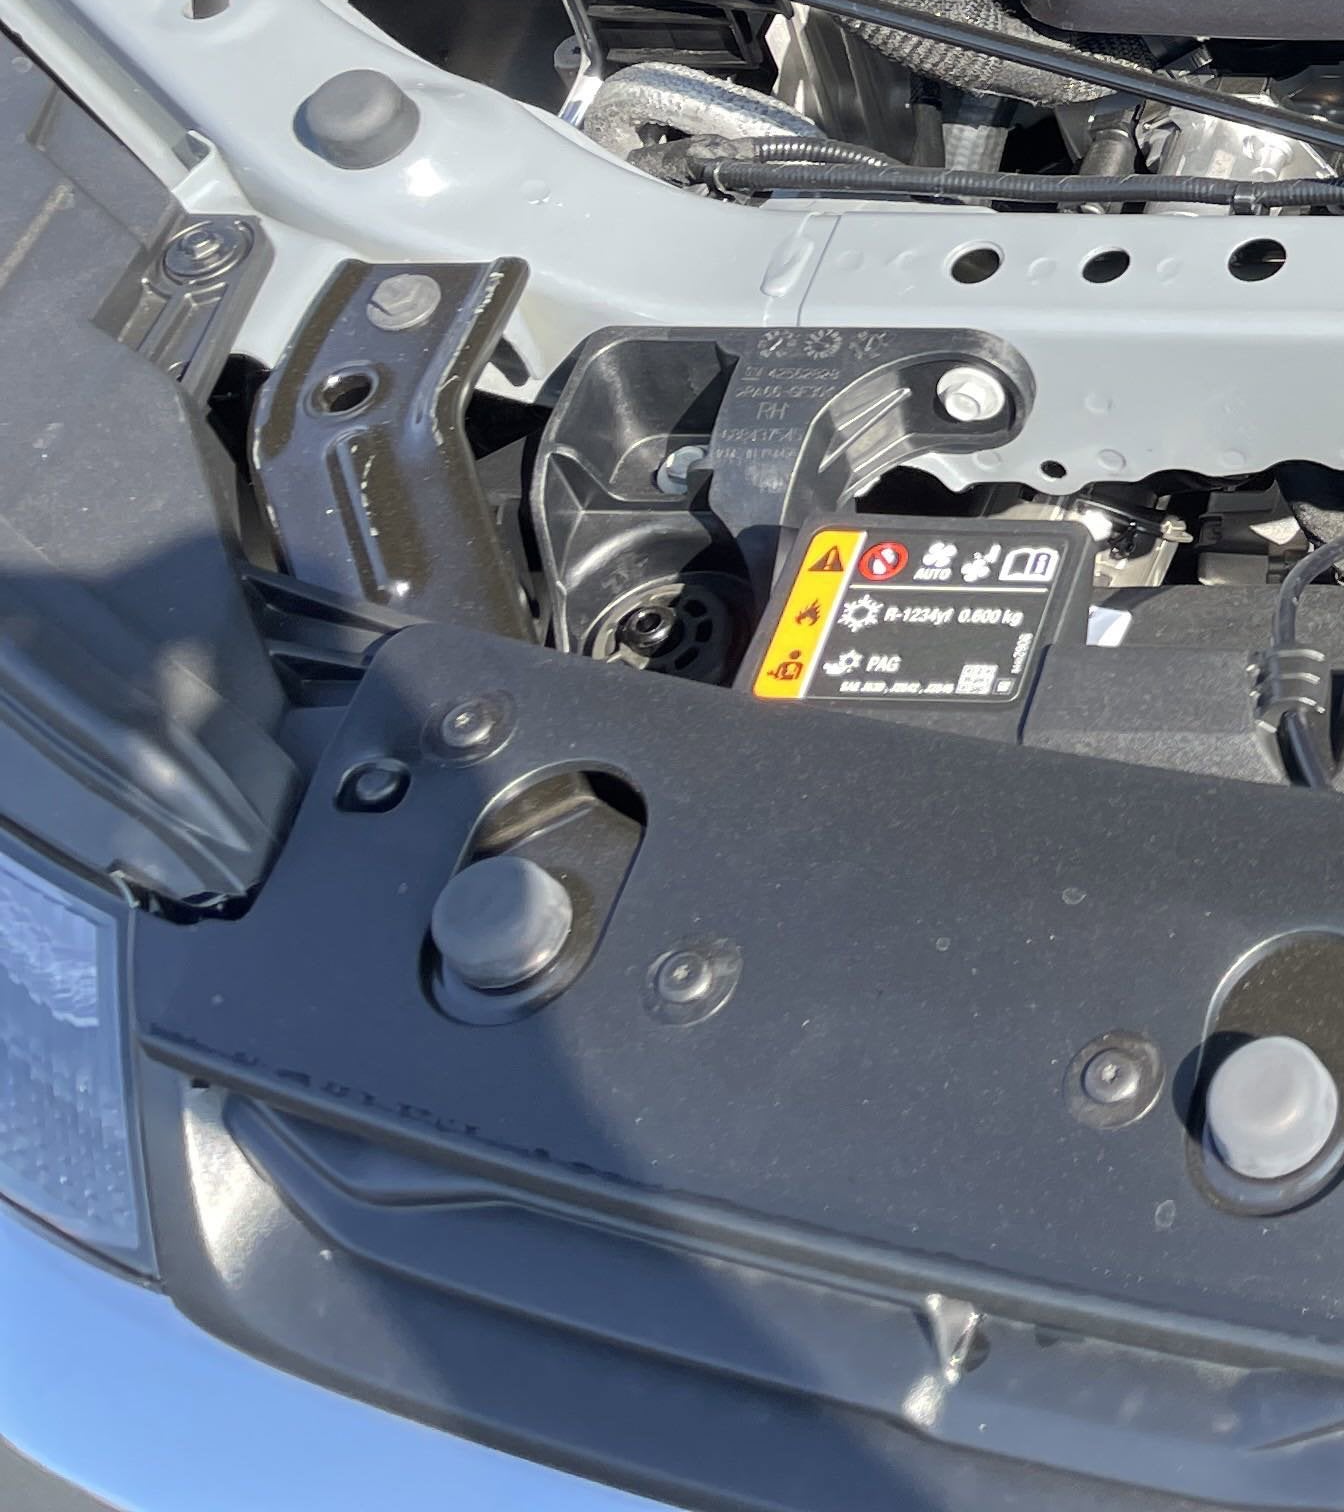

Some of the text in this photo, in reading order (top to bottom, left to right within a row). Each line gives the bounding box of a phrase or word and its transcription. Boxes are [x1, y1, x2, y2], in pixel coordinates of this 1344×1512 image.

[756, 402, 790, 420] RH
[913, 567, 952, 581] AUTO
[1002, 609, 1024, 627] kg
[866, 654, 901, 672] PAG
